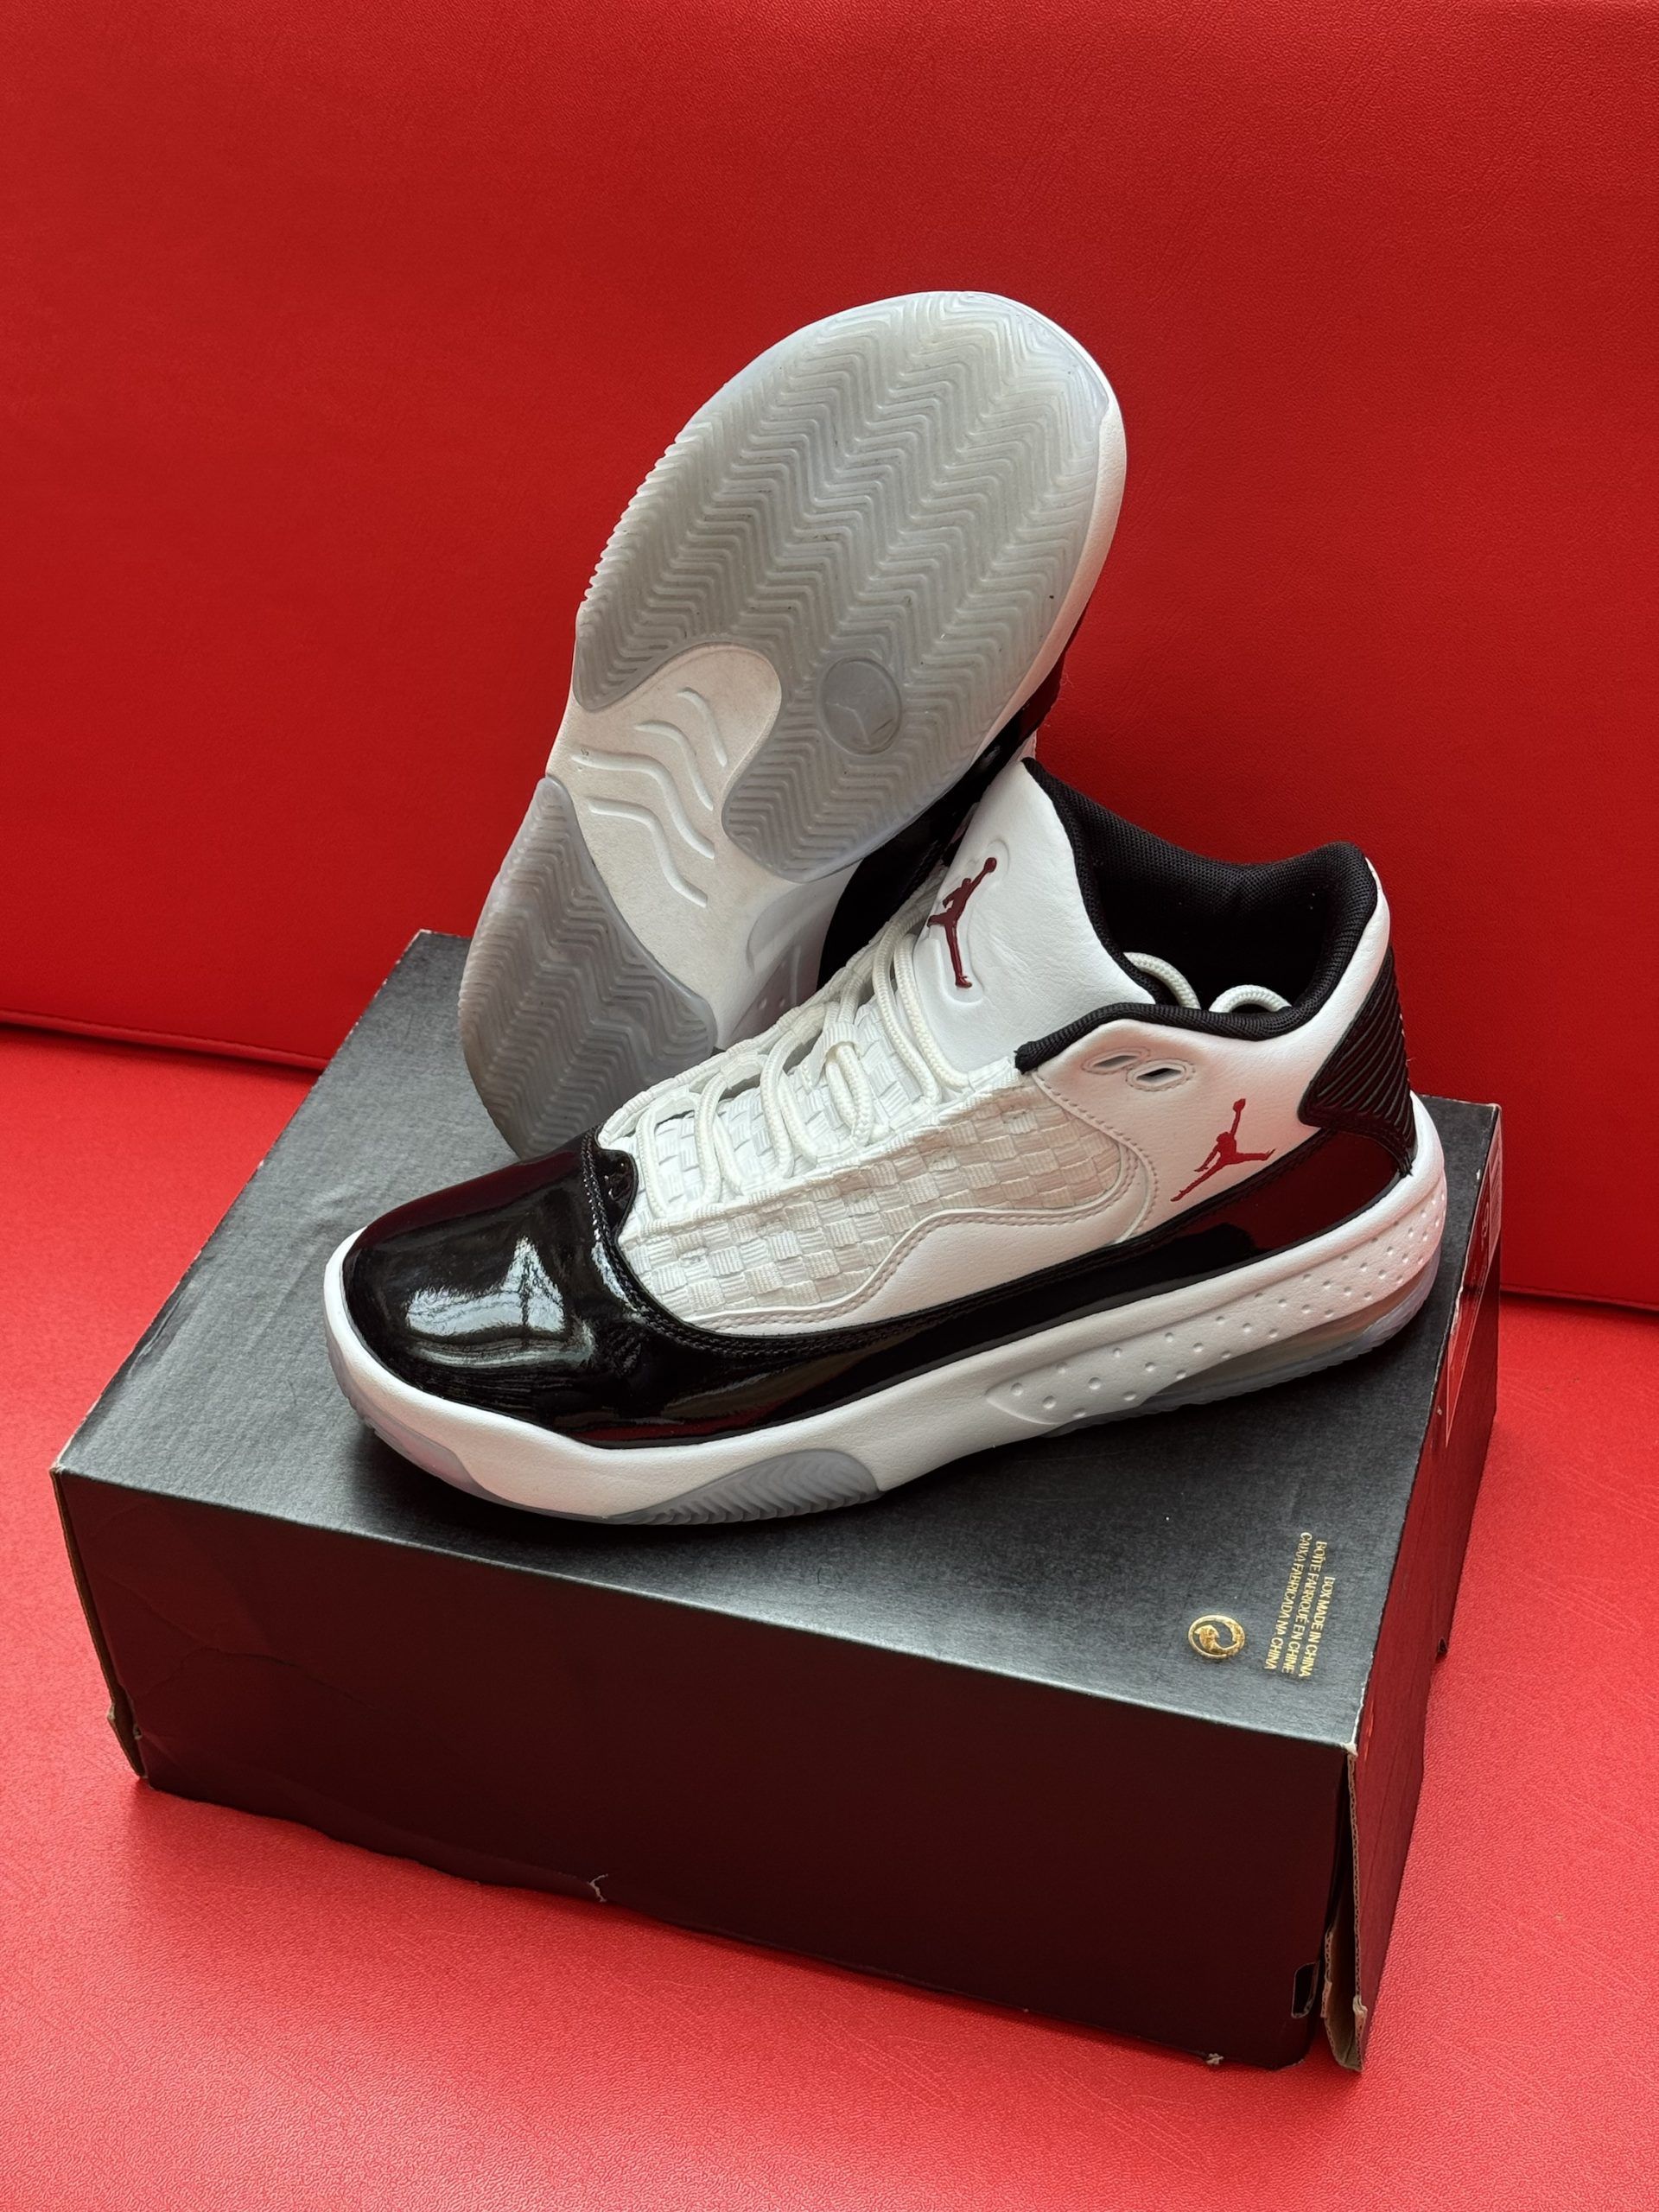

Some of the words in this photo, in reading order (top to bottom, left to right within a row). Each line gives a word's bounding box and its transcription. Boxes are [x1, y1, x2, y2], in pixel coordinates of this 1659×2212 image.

[1294, 1532, 1313, 1562] CAIXA
[1277, 1563, 1305, 1620] FABRICADA
[1319, 1576, 1336, 1599] BOX
[1274, 1619, 1289, 1636] NA
[1311, 1599, 1330, 1630] MADE
[1291, 1624, 1306, 1640] EN
[1307, 1631, 1322, 1643] IN
[1264, 1637, 1284, 1669] CHINA
[1281, 1641, 1301, 1675] CHINE
[1298, 1643, 1319, 1677] CHINA
